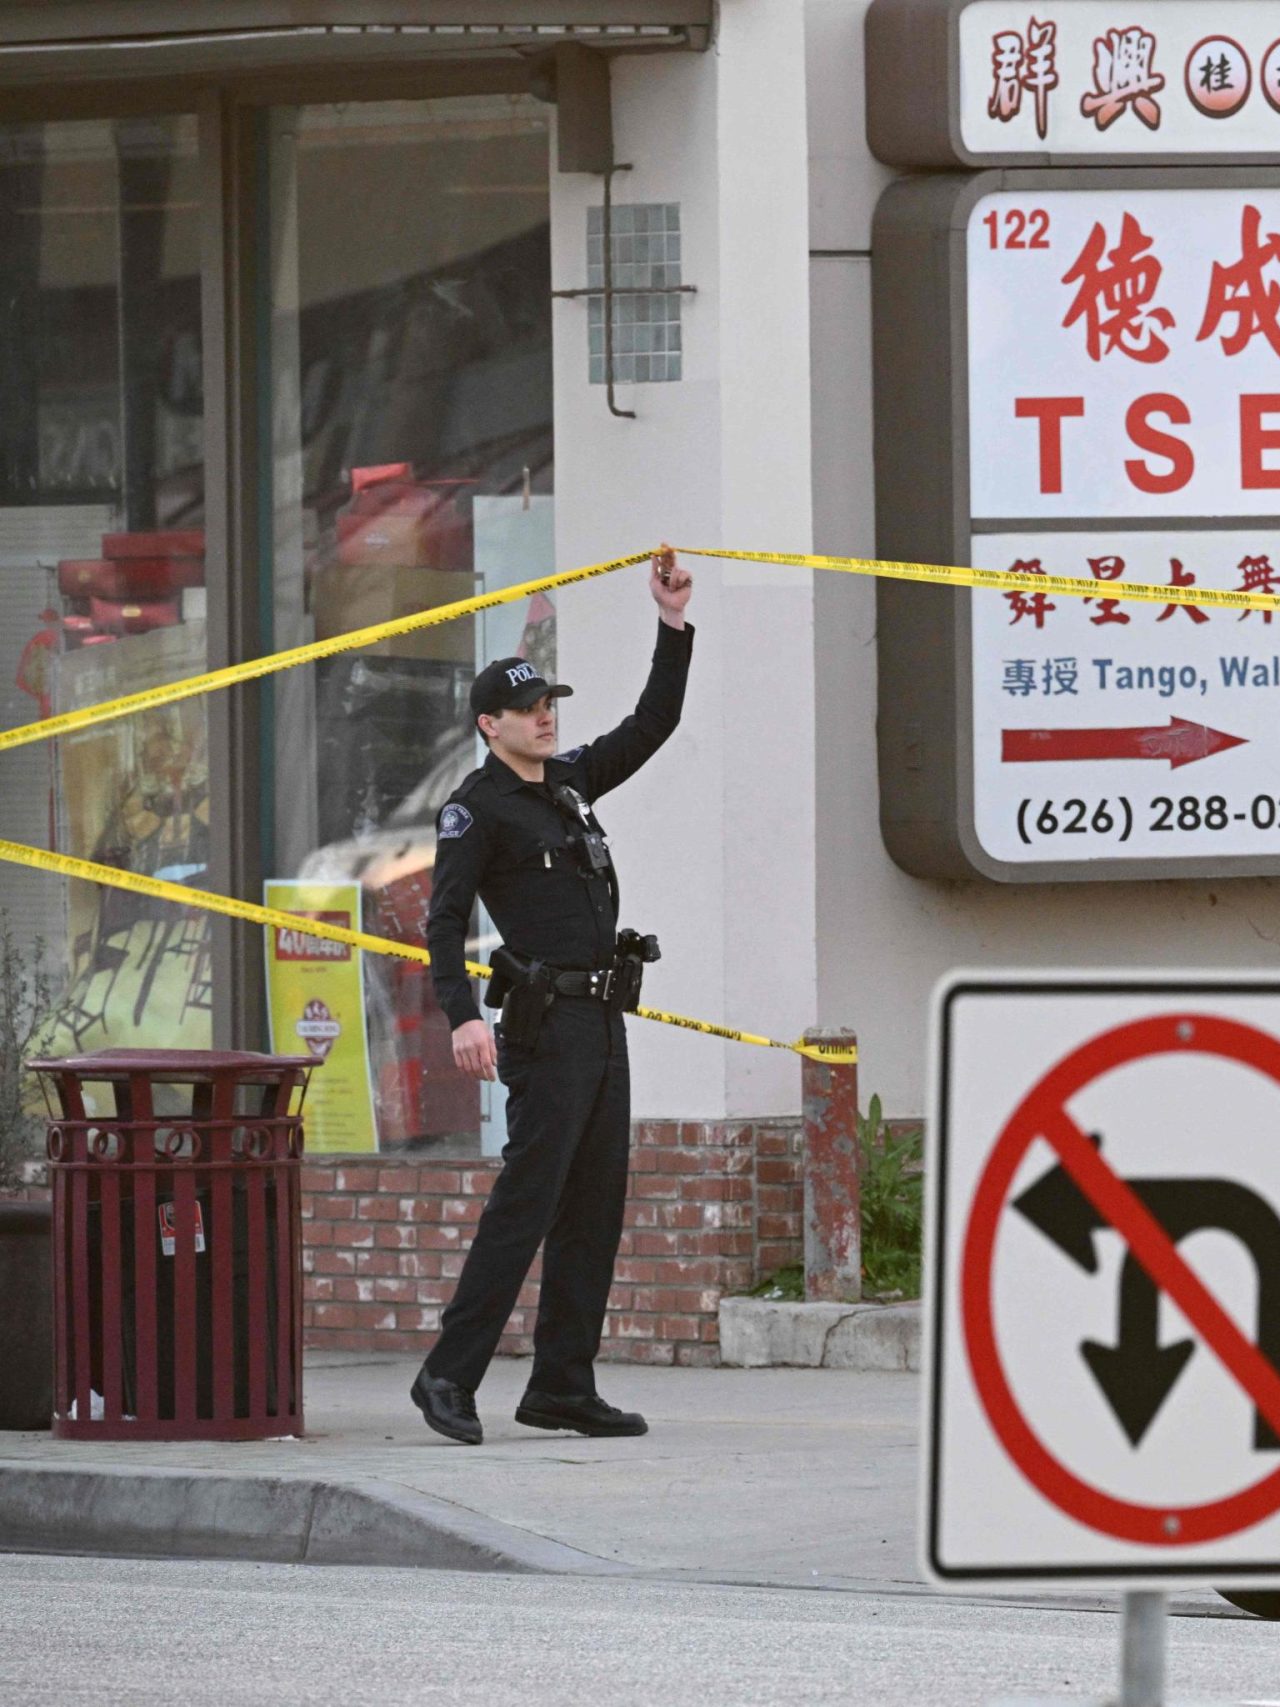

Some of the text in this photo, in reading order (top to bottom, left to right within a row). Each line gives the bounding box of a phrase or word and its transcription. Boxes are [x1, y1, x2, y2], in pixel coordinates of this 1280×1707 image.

[983, 208, 1051, 250] 122
[1014, 396, 1085, 494] T
[1124, 392, 1195, 494] S
[1001, 656, 1079, 697] 專授
[1092, 659, 1208, 698] Tango,
[1016, 795, 1134, 844] (626)
